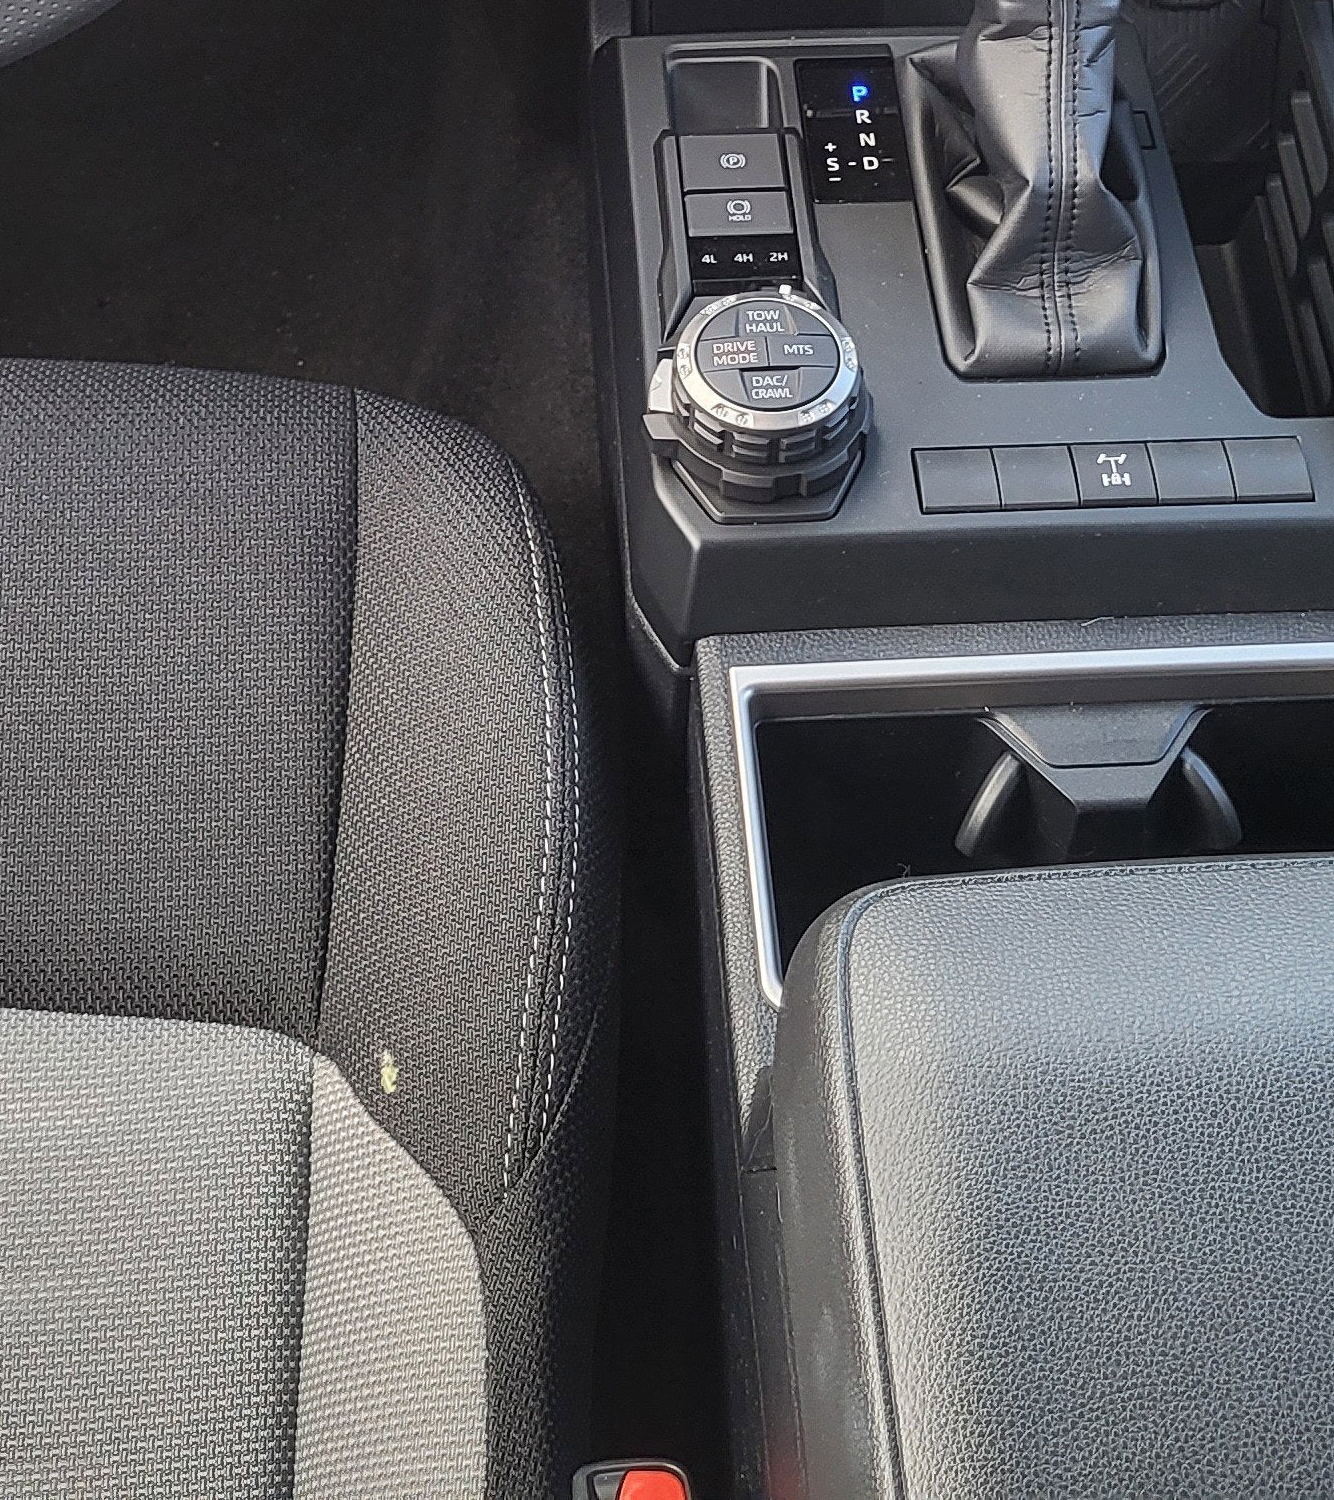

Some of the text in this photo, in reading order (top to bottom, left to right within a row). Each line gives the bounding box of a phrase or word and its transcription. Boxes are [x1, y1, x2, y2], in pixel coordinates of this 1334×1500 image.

[851, 85, 868, 102] P
[855, 109, 872, 124] R
[859, 133, 876, 147] N
[826, 156, 879, 172] S D
[728, 214, 752, 222] HOLD
[701, 252, 789, 264] 4L 4H 2H
[746, 309, 780, 322] TOW
[745, 321, 785, 334] HAUL
[712, 340, 757, 353] DRIVE
[783, 343, 814, 356] MTS
[713, 353, 759, 366] MODE
[751, 374, 788, 388] DAC/
[751, 387, 794, 400] CRAWL
